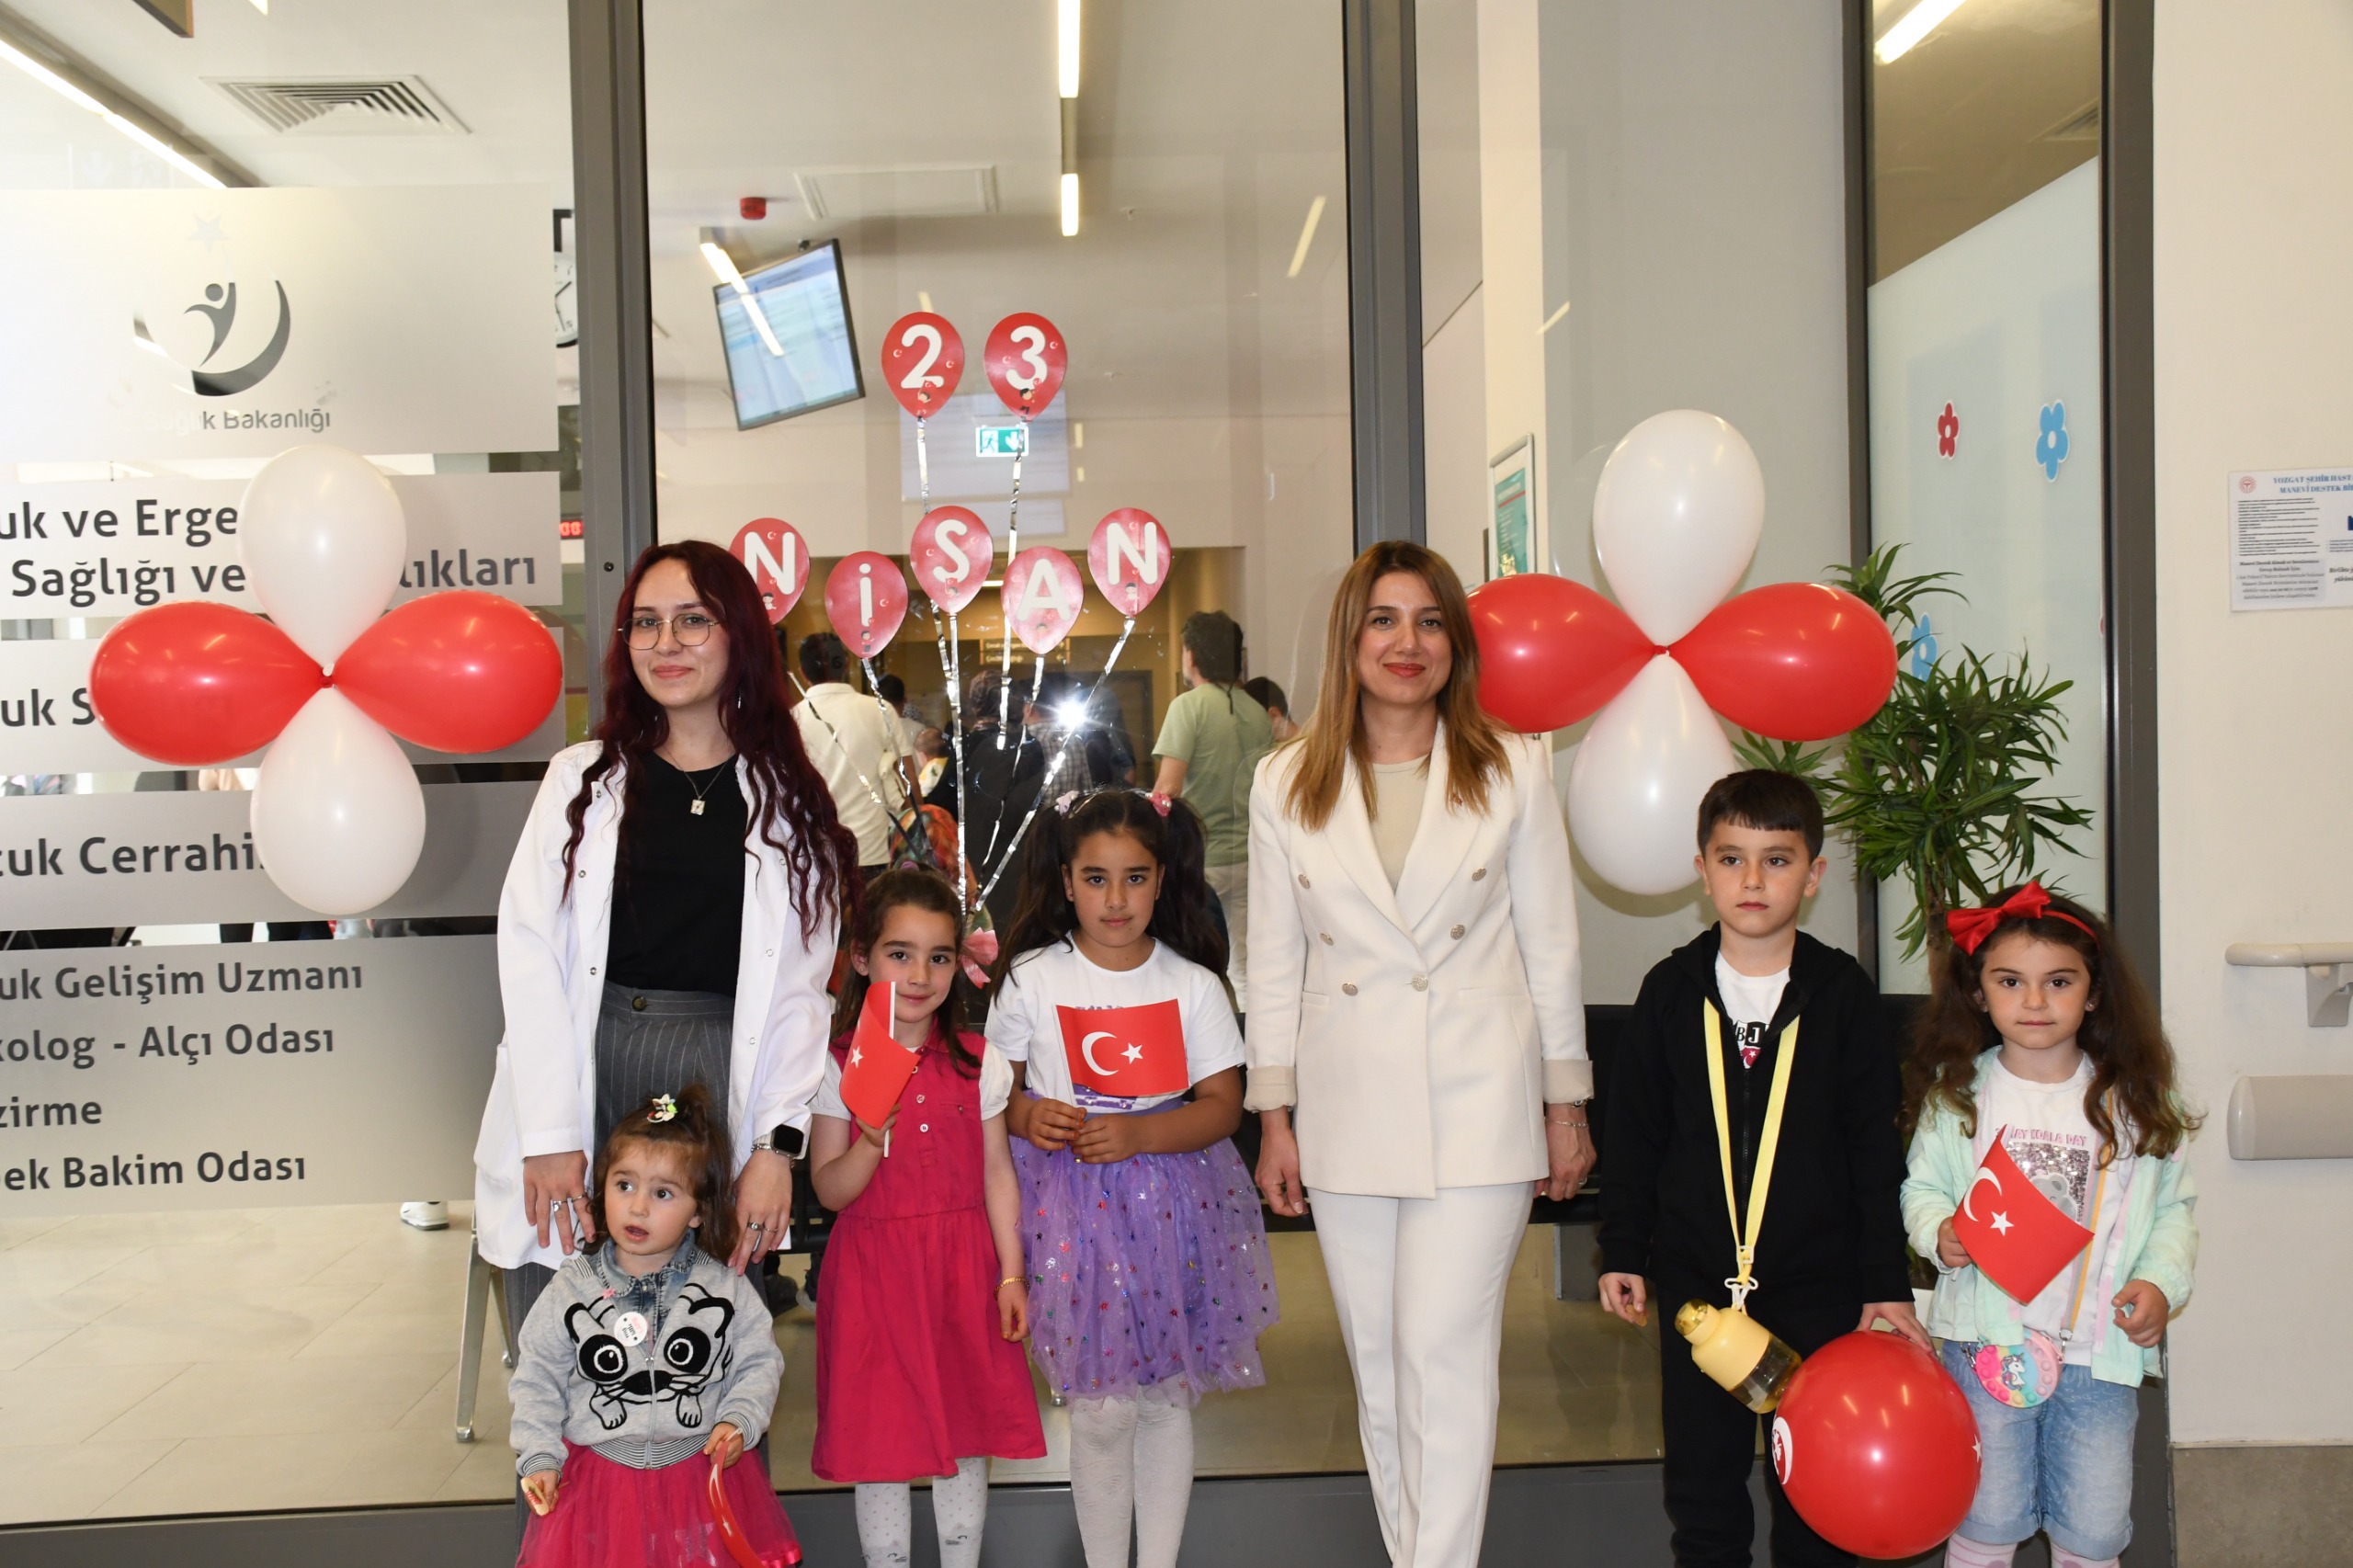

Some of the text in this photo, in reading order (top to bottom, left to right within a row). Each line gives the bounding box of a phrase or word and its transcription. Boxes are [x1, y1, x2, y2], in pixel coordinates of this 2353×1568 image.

[223, 407, 331, 433] Bakanlığı
[2279, 485, 2309, 494] MANEVİ
[63, 509, 119, 538] ve
[136, 499, 238, 547] Erge
[12, 558, 175, 608] Sağlığı
[191, 563, 246, 593] ve
[1, 688, 56, 727] uk
[0, 832, 265, 876] uk Cerrahi
[56, 965, 204, 1004] Gelişim
[218, 962, 362, 993] Uzmanı
[139, 1026, 211, 1065] Alçı
[226, 1023, 334, 1054] Odası
[2030, 1129, 2062, 1143] KOALA
[2066, 1133, 2086, 1146] DAY
[0, 1151, 305, 1190] ek Bakim Odası
